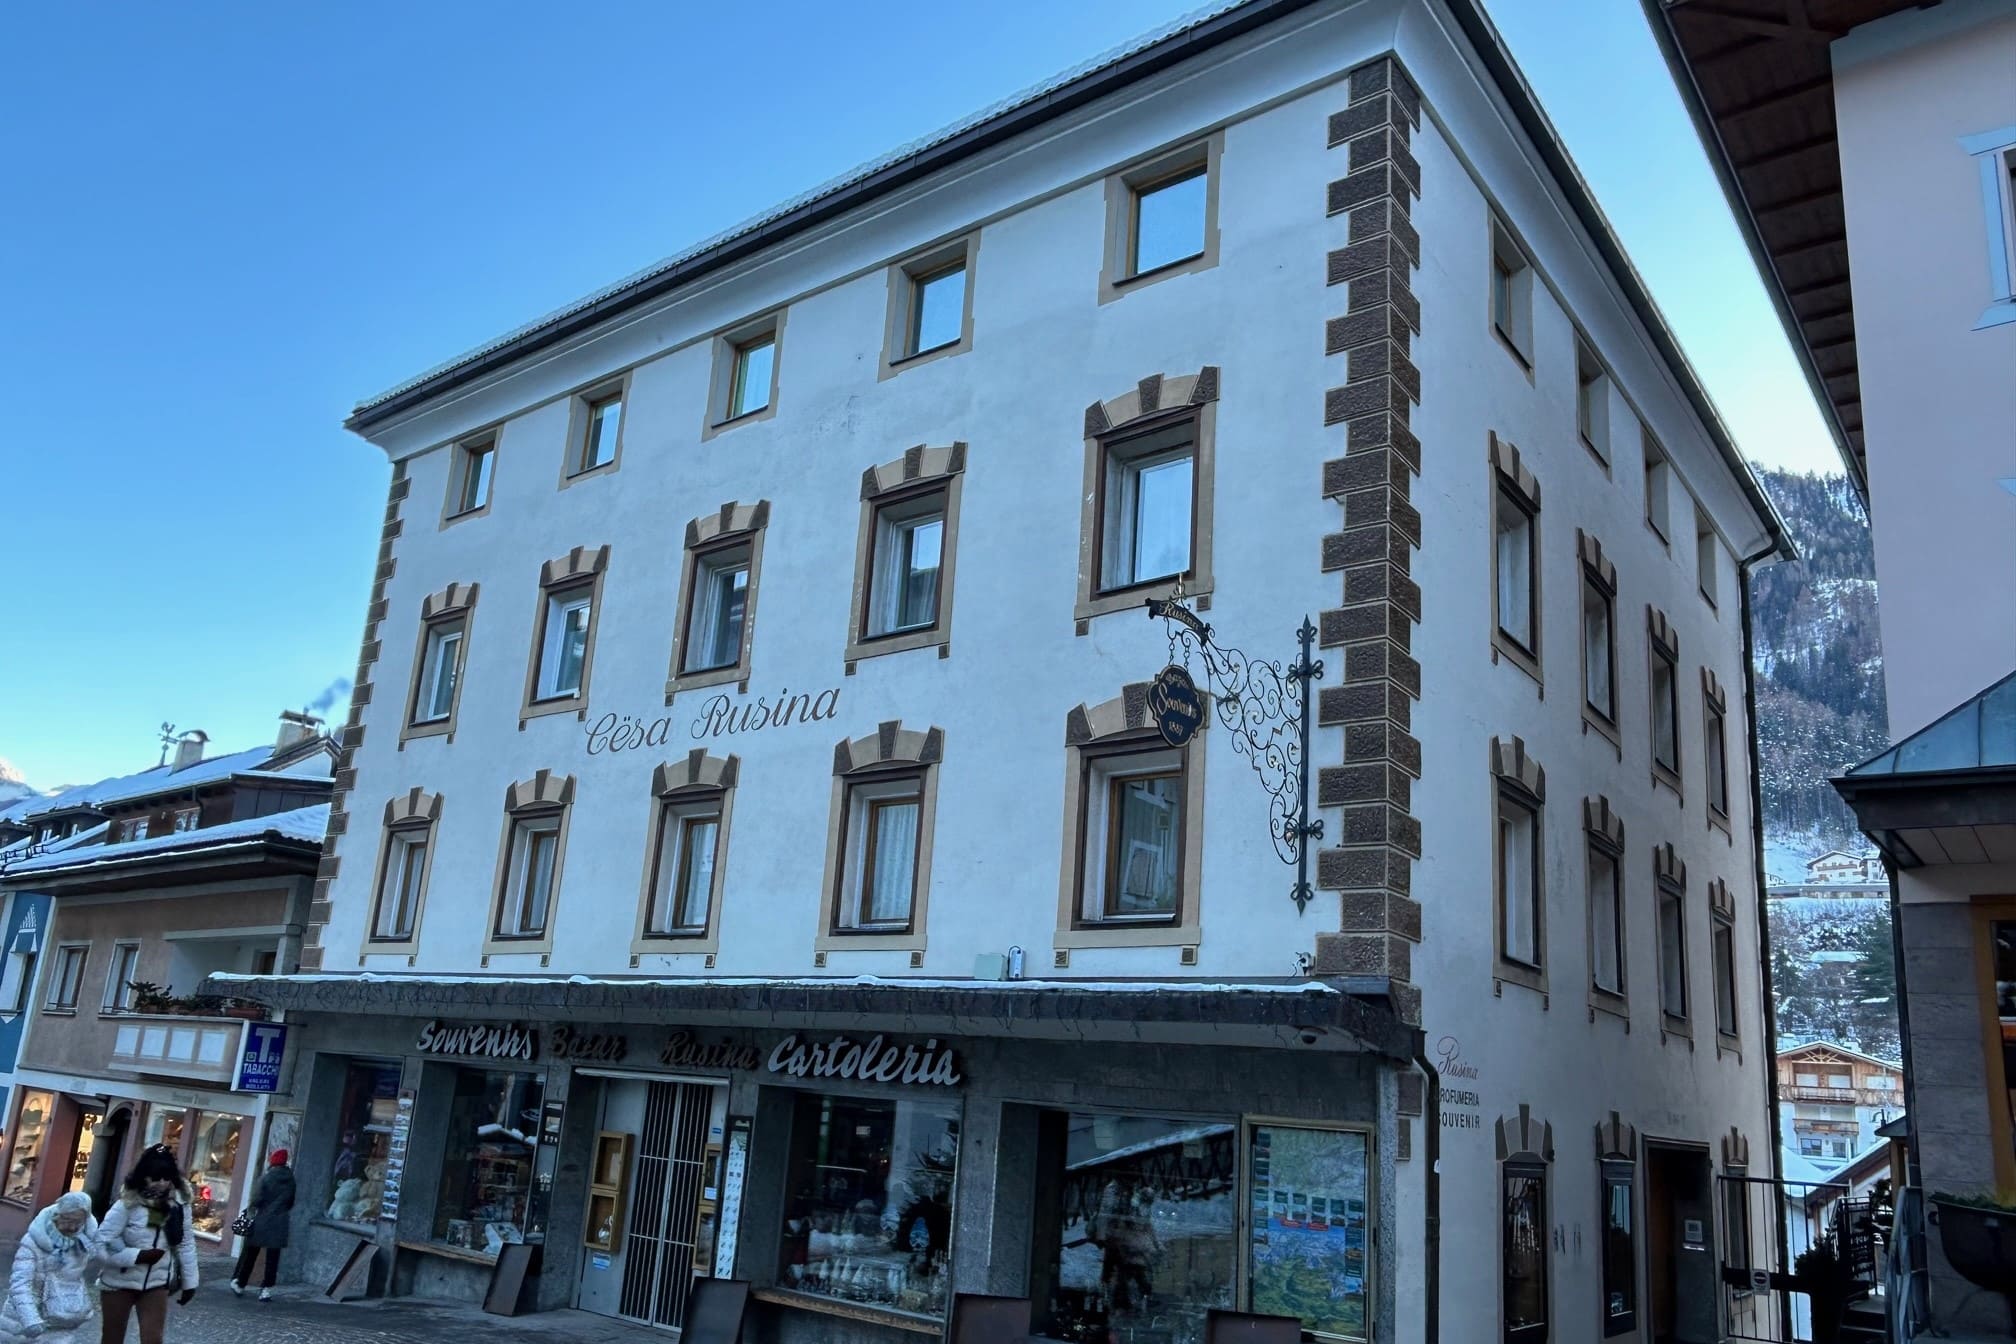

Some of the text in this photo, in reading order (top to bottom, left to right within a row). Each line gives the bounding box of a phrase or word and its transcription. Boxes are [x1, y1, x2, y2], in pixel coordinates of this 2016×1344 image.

[585, 687, 841, 755] Cësa Rusina
[416, 1020, 532, 1060] Souvenirs
[767, 1034, 961, 1086] Cartoleria
[1437, 1036, 1479, 1080] Rusina
[1440, 1087, 1480, 1107] ROFUMERIA
[1439, 1111, 1480, 1129] OUVENIR
